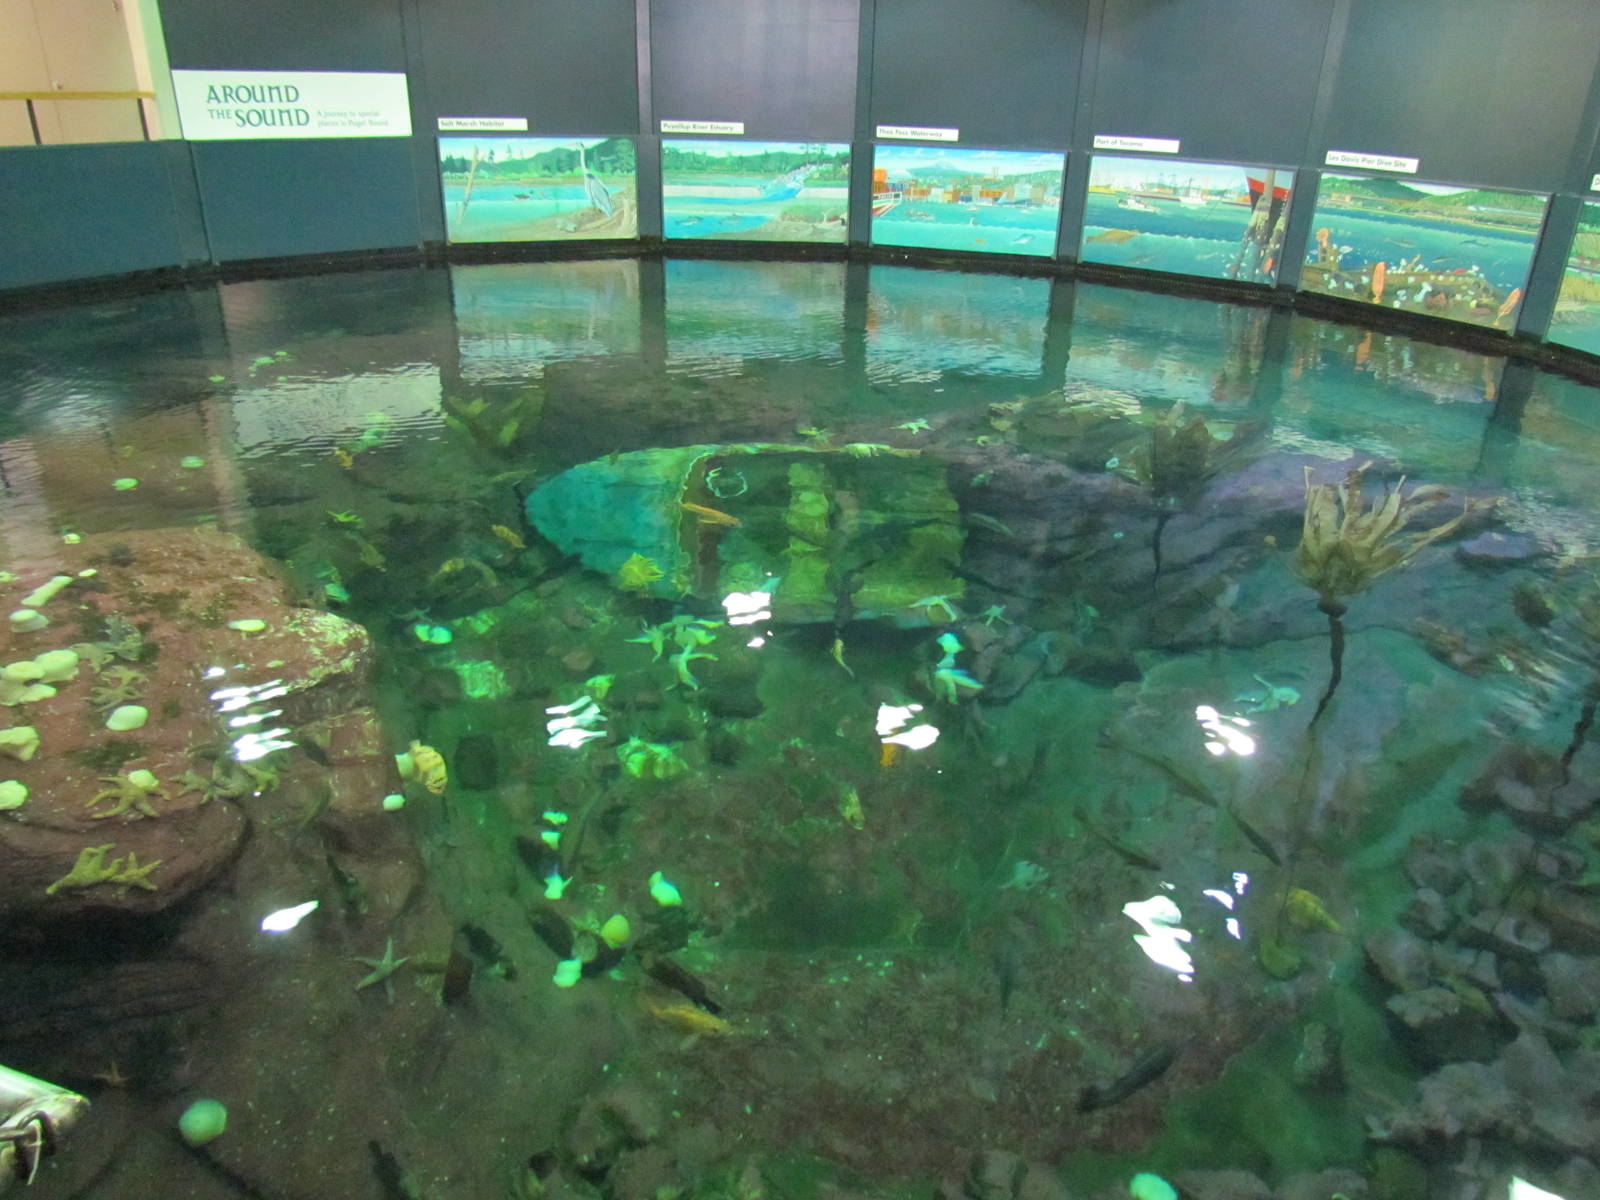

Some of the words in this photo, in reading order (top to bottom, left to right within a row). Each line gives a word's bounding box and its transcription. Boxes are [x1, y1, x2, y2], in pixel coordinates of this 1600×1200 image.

[207, 84, 300, 104] AROUND
[207, 109, 233, 119] THE
[234, 108, 310, 127] SOUND
[440, 120, 454, 128] Salt
[455, 120, 478, 128] Marsh
[479, 120, 505, 128] Habitat
[910, 130, 943, 138] Waterway
[1340, 154, 1360, 163] Davis
[1376, 158, 1393, 166] Dive
